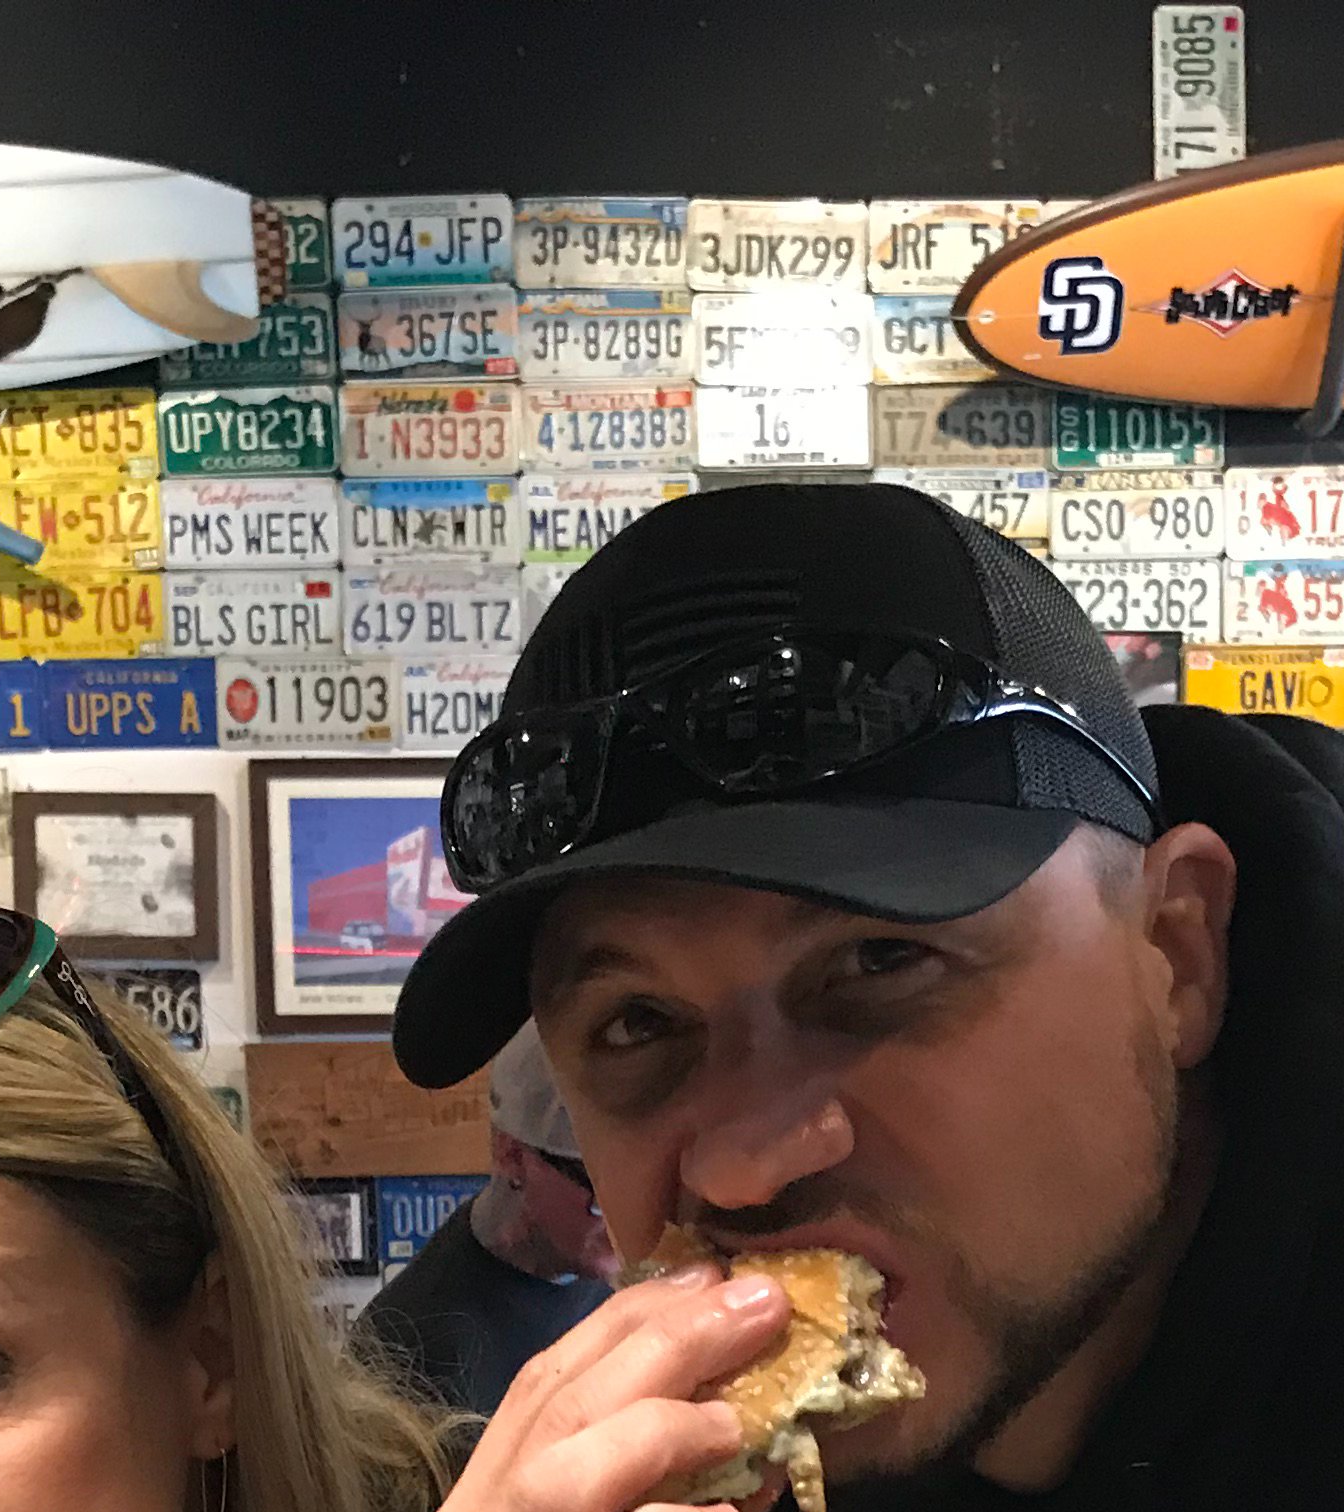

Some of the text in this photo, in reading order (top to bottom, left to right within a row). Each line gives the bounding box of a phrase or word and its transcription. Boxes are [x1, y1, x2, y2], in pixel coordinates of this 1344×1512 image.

[344, 218, 503, 268] 294 JFP
[168, 511, 234, 558] PMS
[1149, 495, 1216, 541] 980
[246, 600, 335, 647] GIRL
[351, 599, 514, 644] 619 BLTZ
